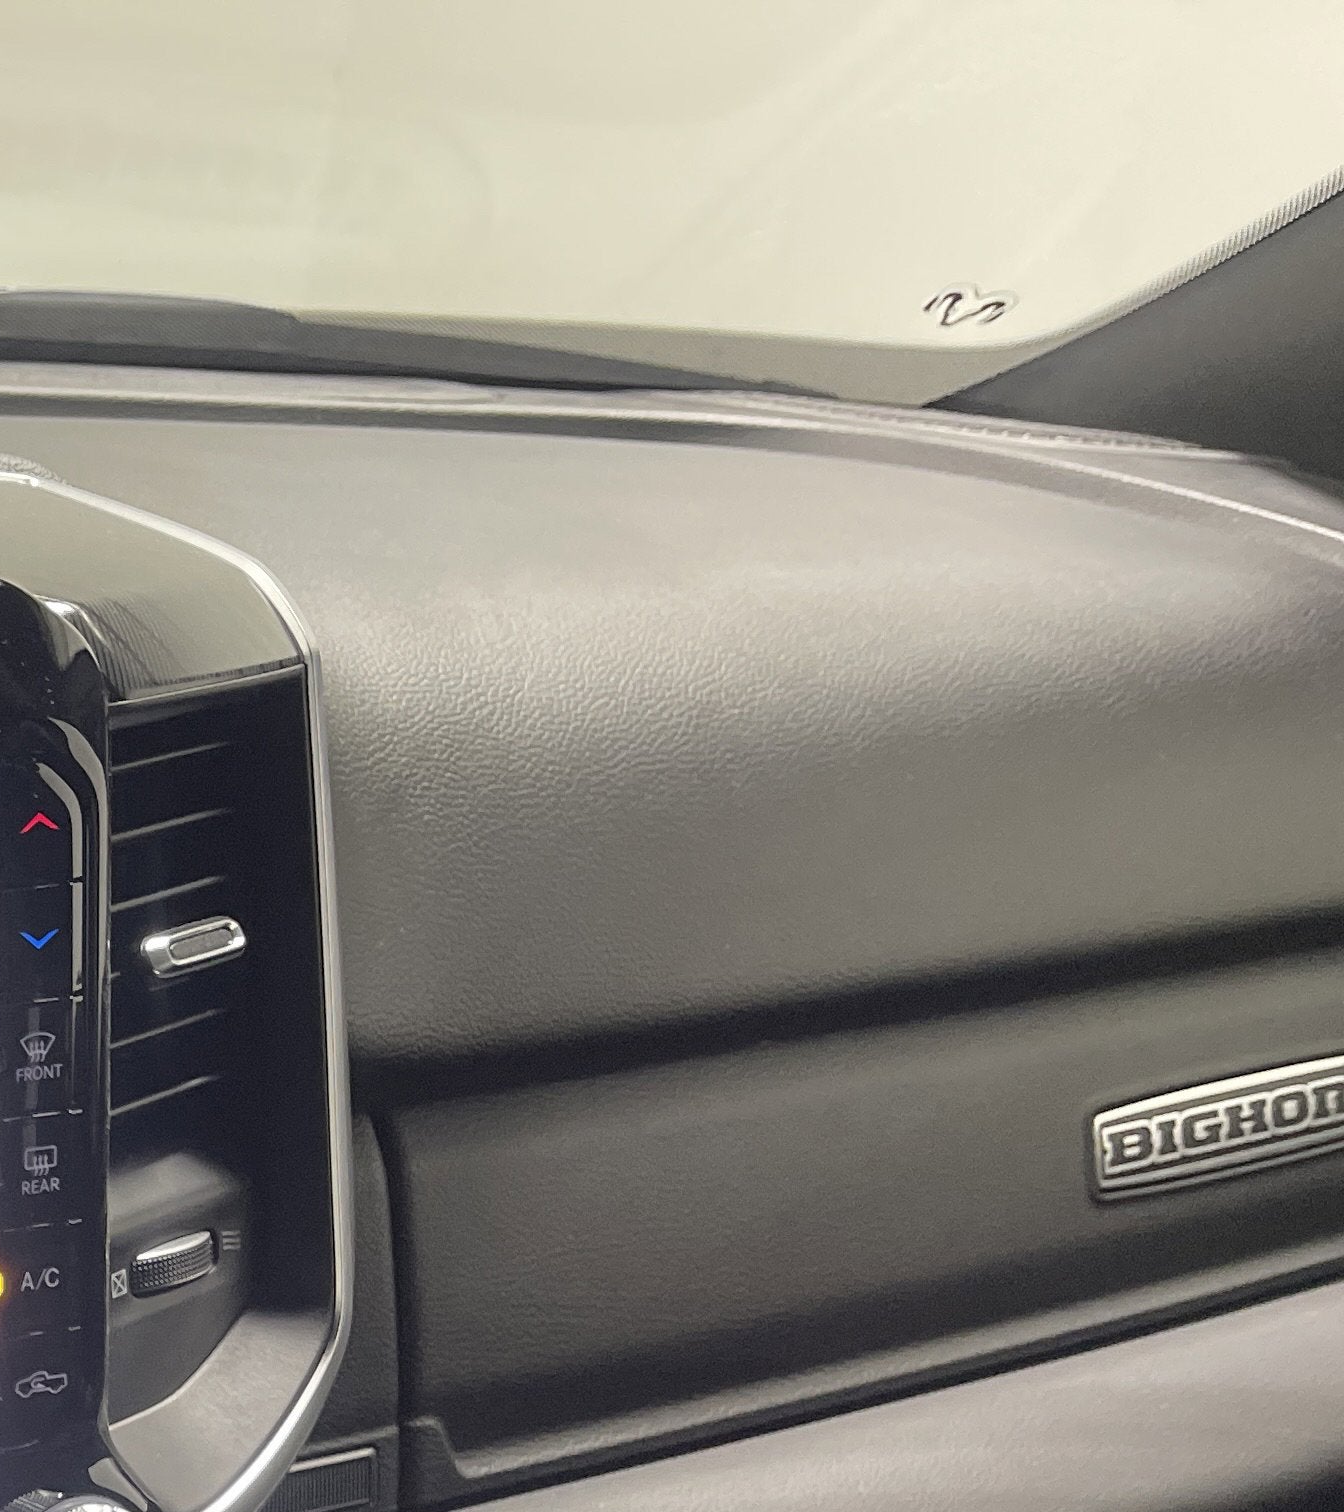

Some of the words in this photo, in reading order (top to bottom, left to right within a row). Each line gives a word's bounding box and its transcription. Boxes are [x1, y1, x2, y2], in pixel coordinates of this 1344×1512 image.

[15, 1063, 63, 1083] FRONT
[21, 1177, 61, 1196] REAR
[20, 1266, 60, 1291] A/C
